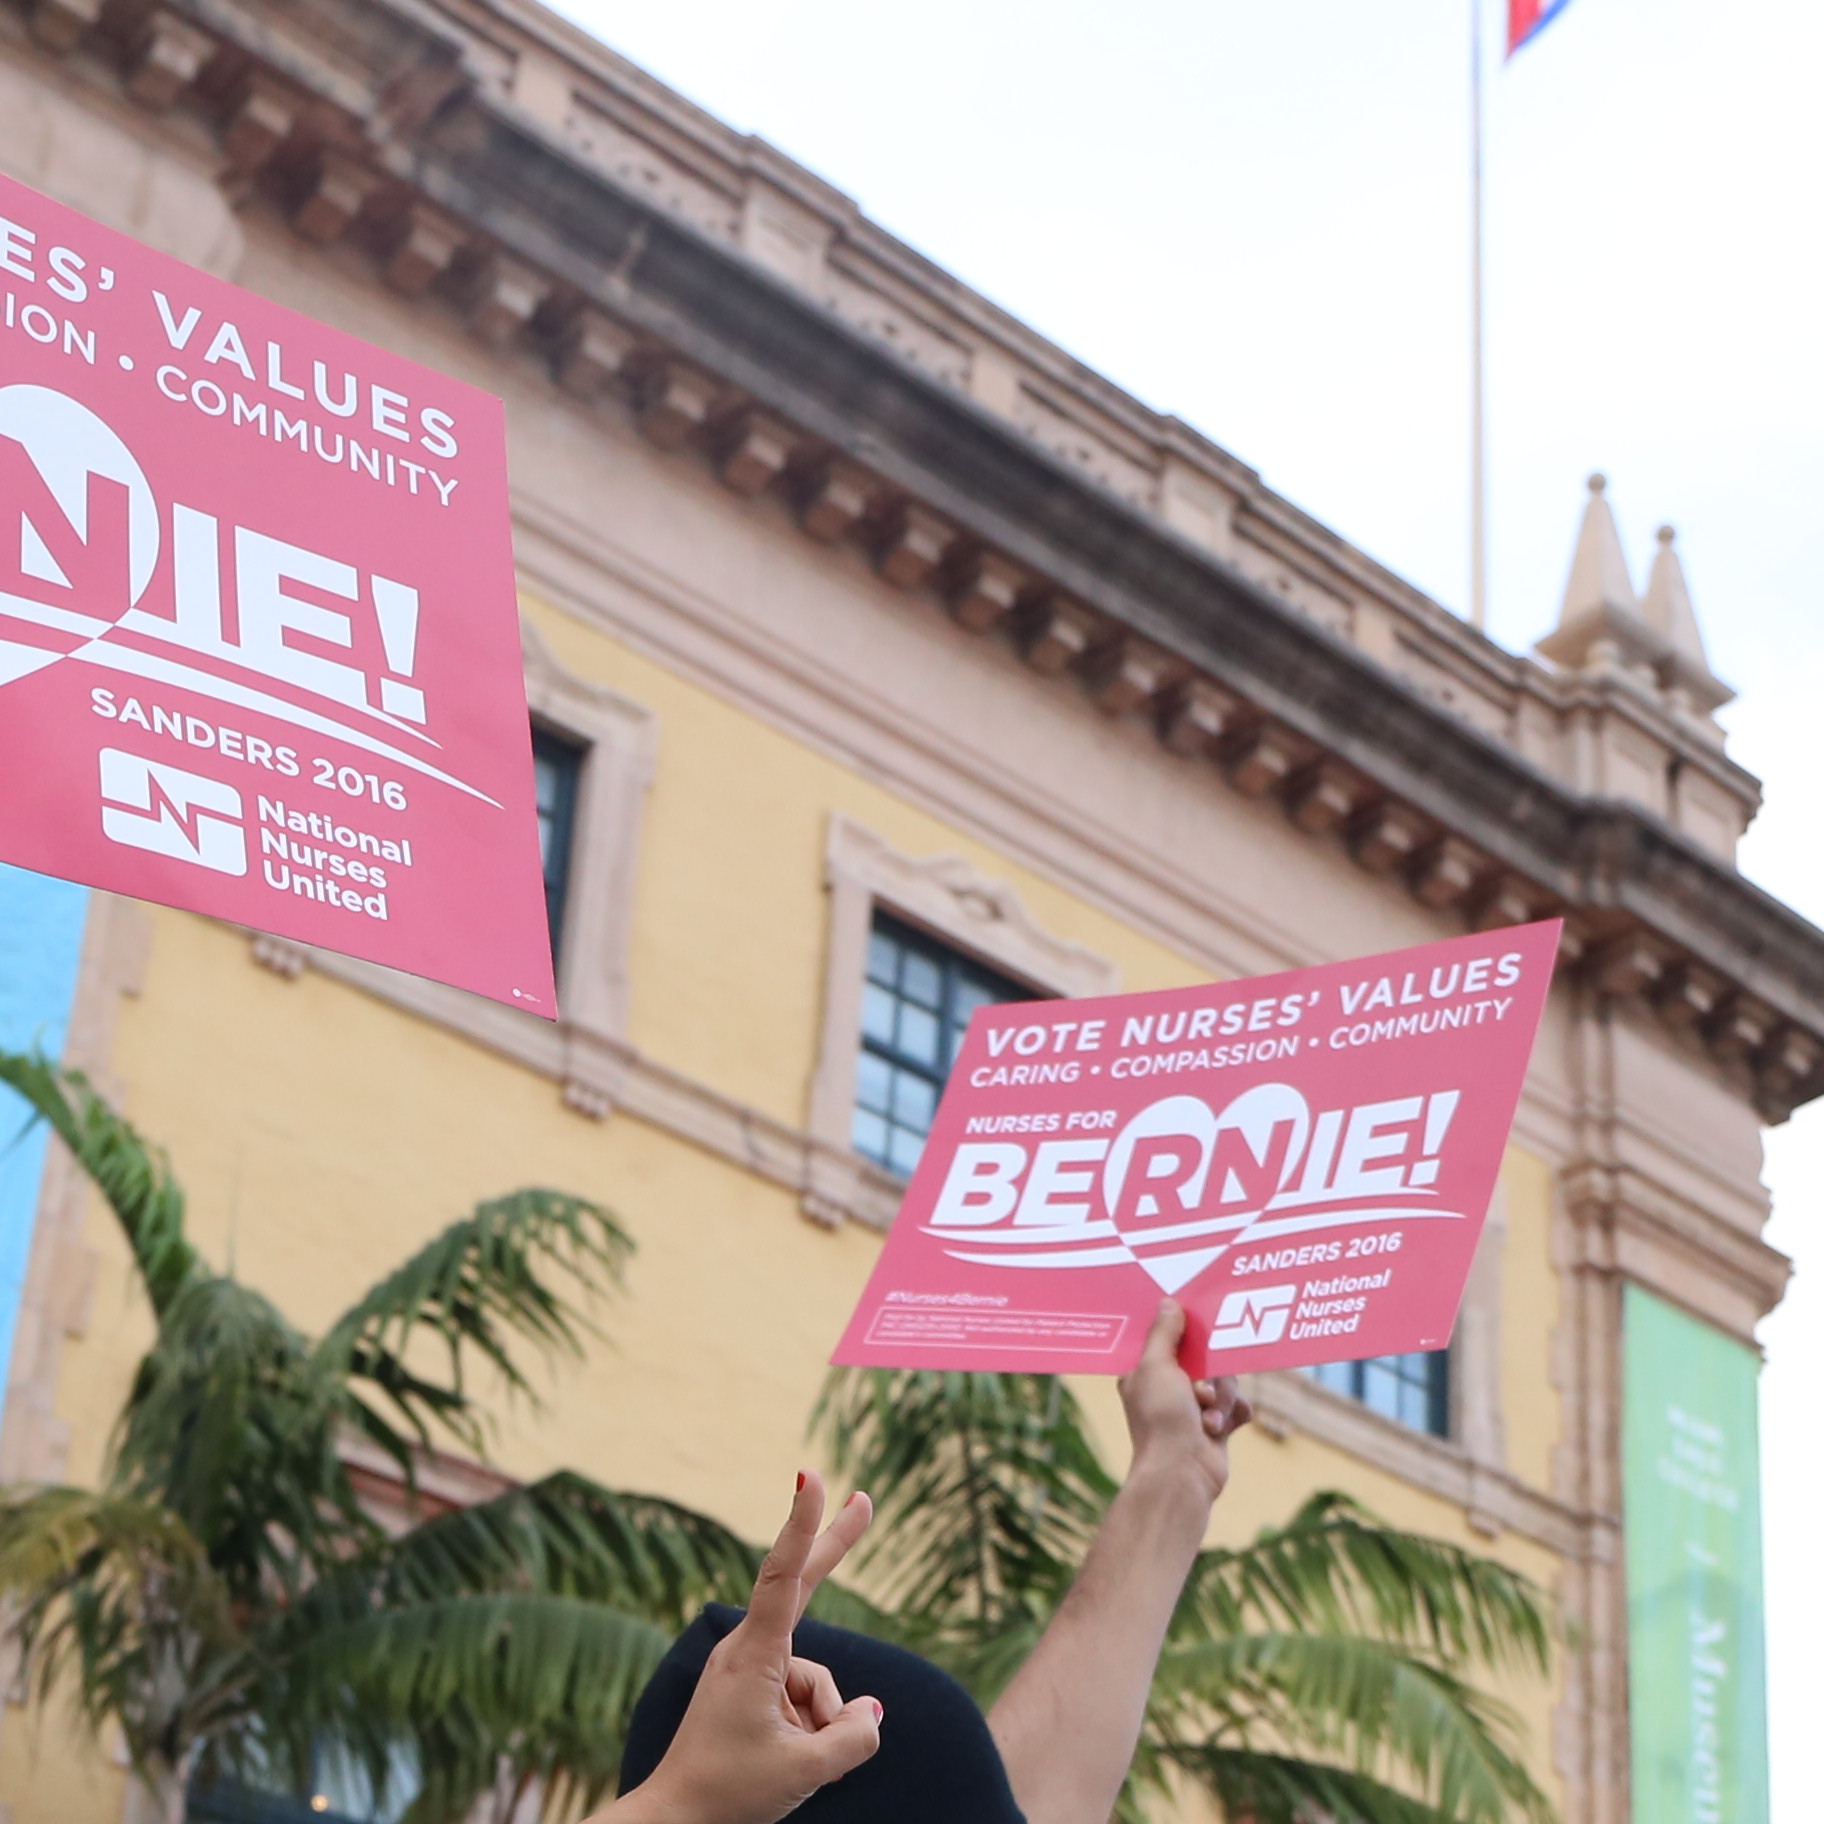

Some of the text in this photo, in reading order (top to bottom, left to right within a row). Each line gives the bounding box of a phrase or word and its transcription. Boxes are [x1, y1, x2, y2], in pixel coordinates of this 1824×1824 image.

[151, 289, 459, 459] VALUES
[155, 364, 460, 508] COMMUNITY
[90, 686, 408, 811] SANDERS 2016
[257, 794, 413, 867] National
[260, 827, 388, 889] Nurses
[263, 859, 390, 921] United
[985, 1020, 1106, 1058] VOTE
[1339, 952, 1523, 1016] VALUES
[971, 997, 1514, 1089] CARING COMPASSION COMMUNITY
[965, 1110, 1118, 1135] NURSES FOR
[930, 1089, 1461, 1227] BERNIE!
[1232, 1231, 1404, 1277] SANDERS 2016
[1301, 1267, 1393, 1300] National
[1289, 1313, 1360, 1341] United
[1294, 1295, 1366, 1320] Nurses
